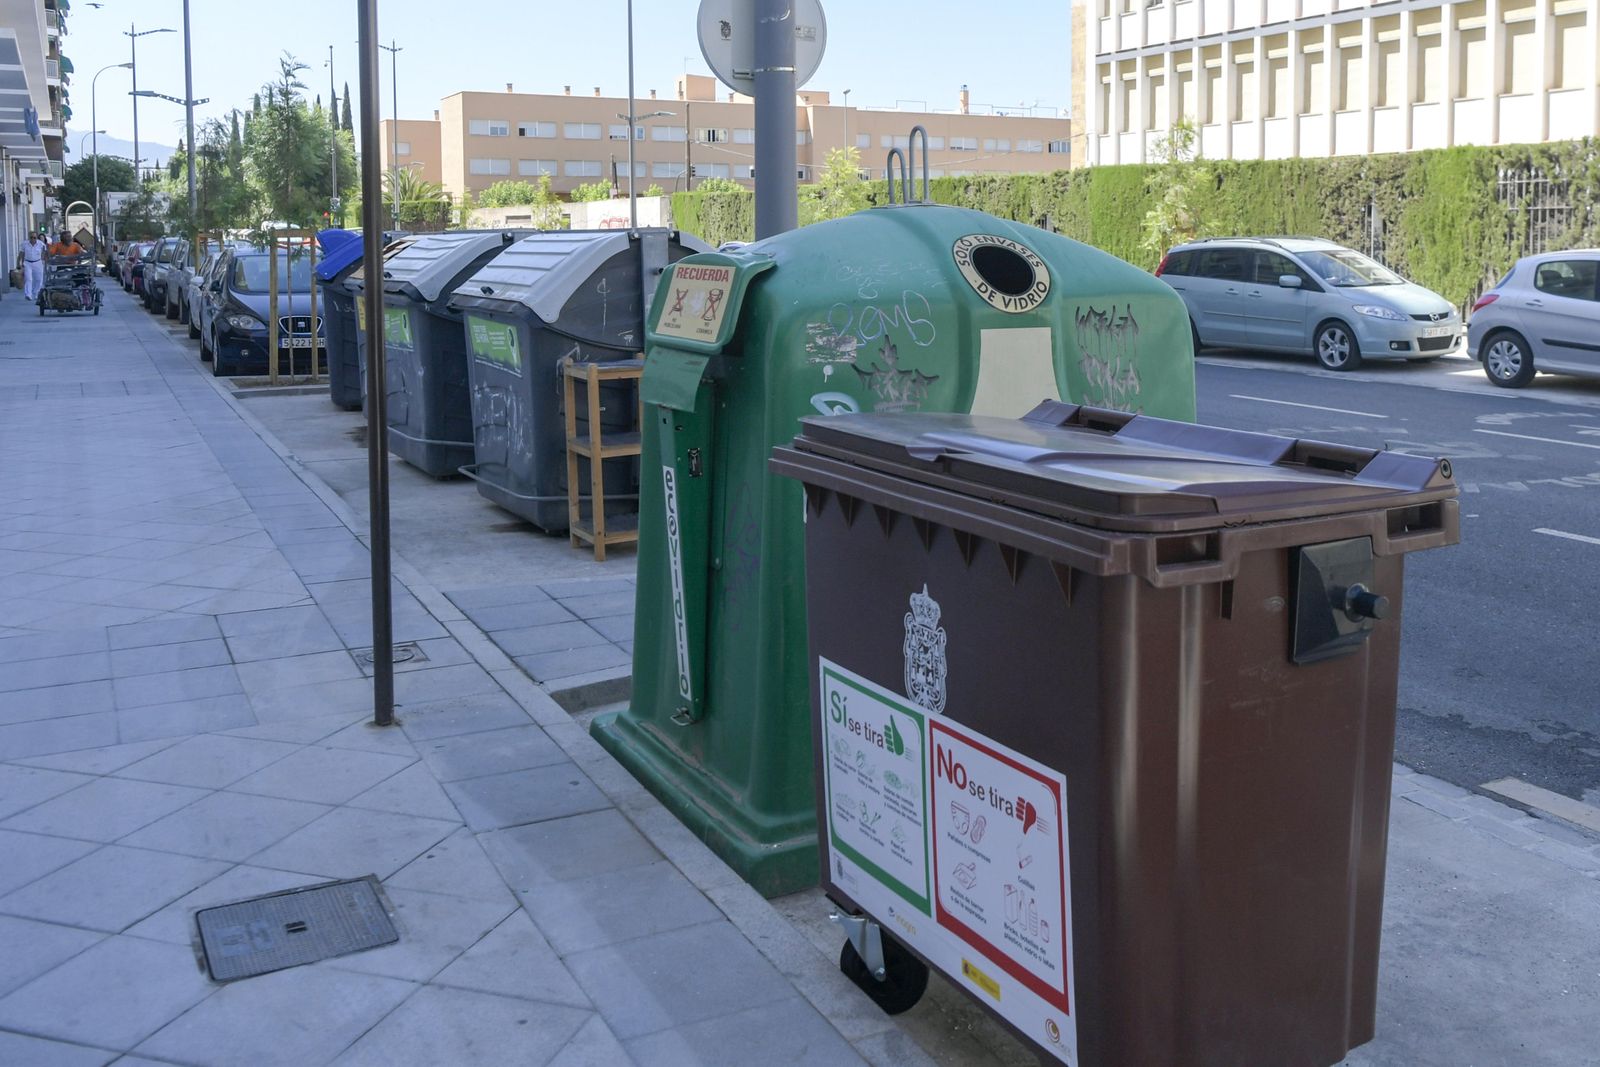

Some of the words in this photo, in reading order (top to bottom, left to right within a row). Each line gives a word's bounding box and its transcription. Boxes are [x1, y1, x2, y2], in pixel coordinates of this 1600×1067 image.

[955, 239, 973, 267] SOLO
[973, 236, 1043, 268] ENVASES
[676, 267, 729, 282] RECUERDA
[977, 282, 997, 302] DE
[1002, 281, 1048, 310] VIDRIO
[283, 339, 306, 347] 522
[665, 470, 689, 695] ecovidrio
[831, 690, 847, 729] Sí
[848, 718, 862, 736] se
[864, 722, 884, 749] tira
[969, 780, 985, 801] se
[989, 786, 1014, 818] tira
